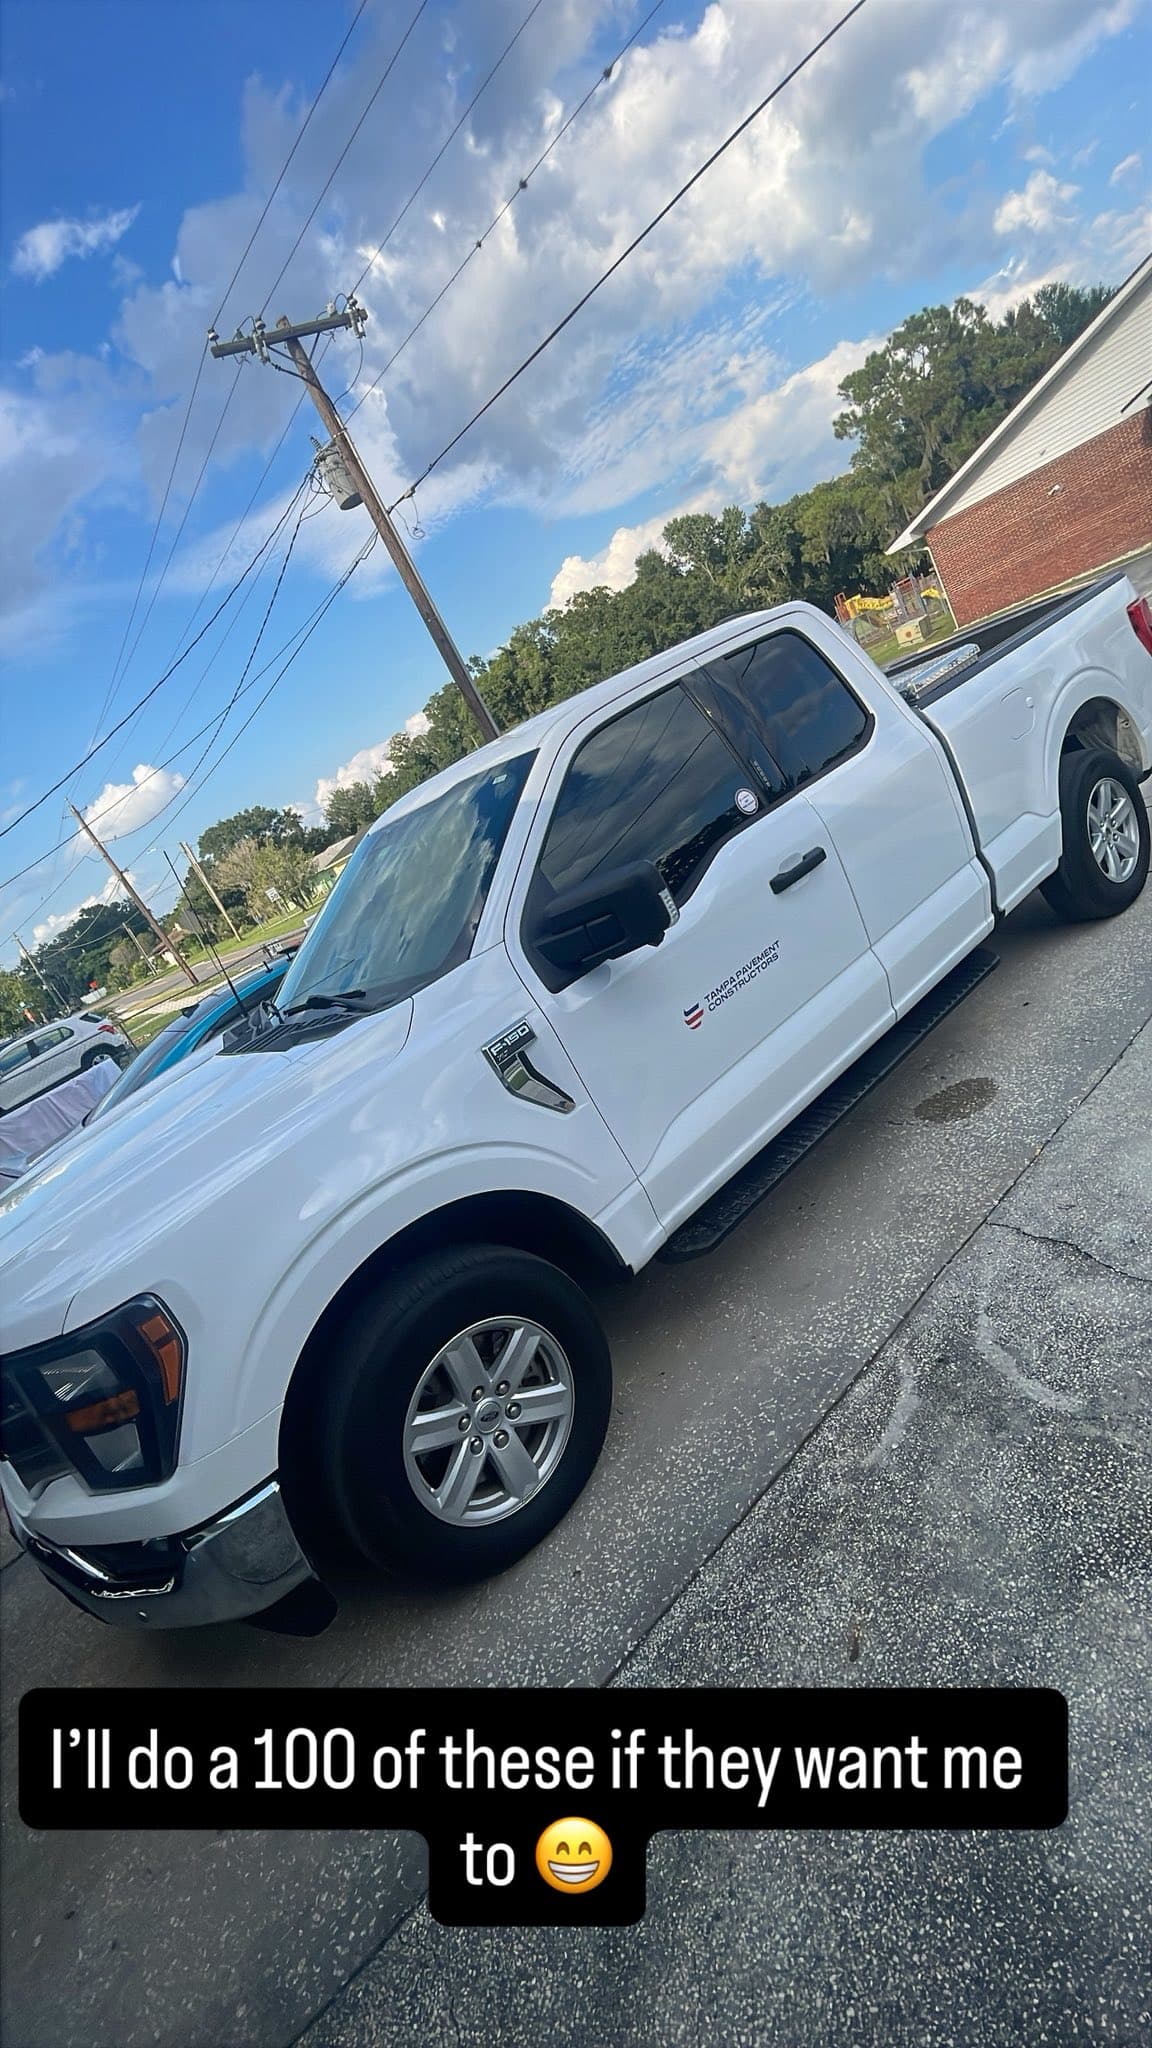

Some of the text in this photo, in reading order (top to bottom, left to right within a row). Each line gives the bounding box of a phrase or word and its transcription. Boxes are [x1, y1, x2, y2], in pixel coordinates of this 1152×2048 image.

[704, 940, 780, 1003] TAMPA PAVEMENT
[708, 953, 779, 1012] CONSTRUCTORS
[490, 1025, 530, 1057] F-150
